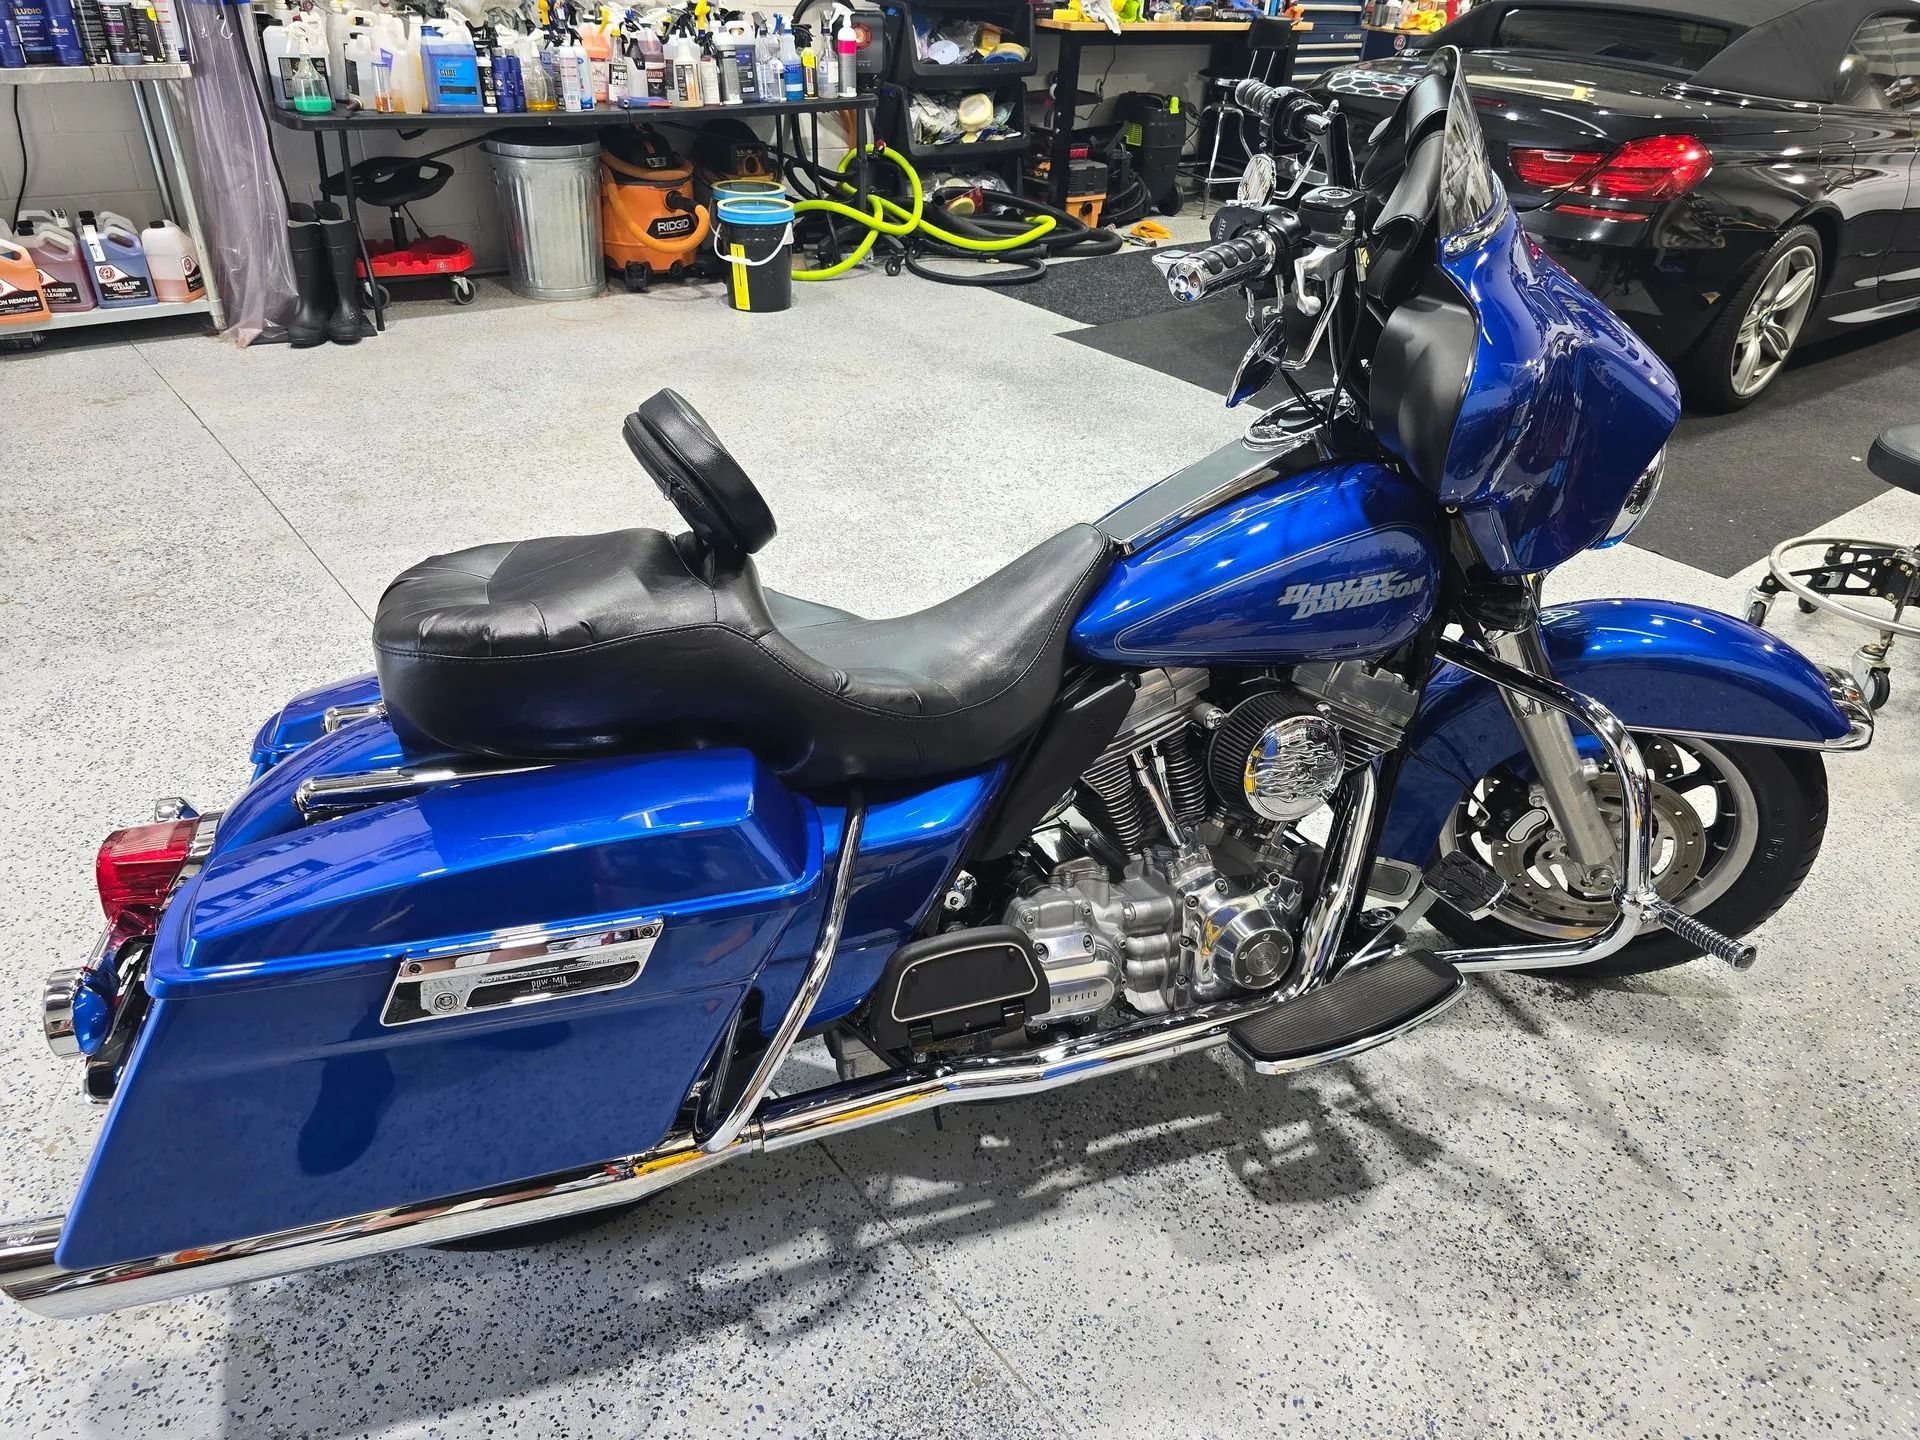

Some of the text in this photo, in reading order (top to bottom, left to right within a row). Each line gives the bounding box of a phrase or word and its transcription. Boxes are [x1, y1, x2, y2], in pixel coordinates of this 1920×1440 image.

[657, 219, 690, 232] RIDGID
[1217, 218, 1227, 240] ATLAS
[8, 296, 38, 305] REMOVER
[1277, 569, 1409, 607] HARLEY
[1290, 575, 1426, 621] DAVIDSON
[1067, 990, 1098, 1002] SPEED
